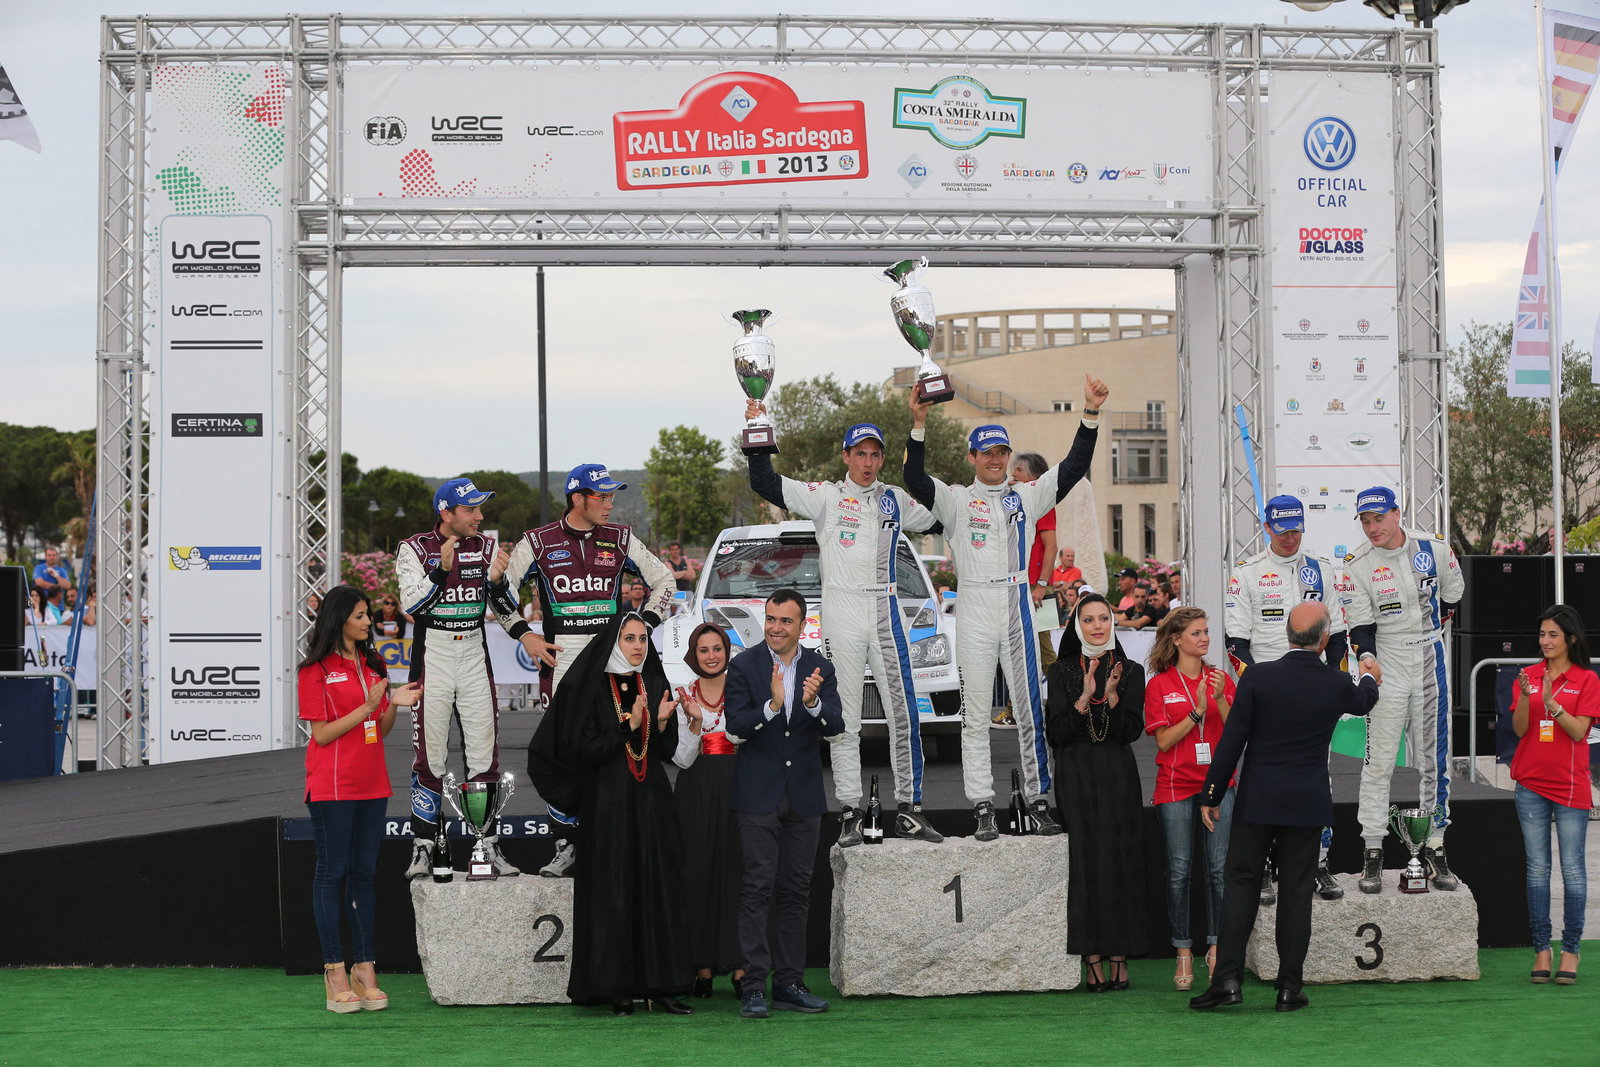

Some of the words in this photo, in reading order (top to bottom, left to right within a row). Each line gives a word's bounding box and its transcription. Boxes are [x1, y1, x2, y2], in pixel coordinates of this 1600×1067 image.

[902, 103, 943, 117] COSTA
[945, 107, 1016, 123] SMERALDA
[431, 116, 503, 131] WRC
[938, 118, 980, 127] SARDEGNA
[627, 129, 701, 156] RALLY
[706, 130, 757, 152] Italia
[762, 126, 854, 151] Sardegna
[632, 164, 712, 179] SARDEGNA
[777, 154, 829, 175] 2013
[1003, 169, 1056, 178] SARDEGNA
[1169, 166, 1191, 175] Coni
[1297, 177, 1367, 191] OFFICIAL
[1317, 194, 1347, 208] CAR
[1299, 227, 1364, 241] DOCTOR
[171, 240, 260, 259] WRC
[1312, 241, 1364, 254] GLASS
[176, 418, 243, 427] CERTINA
[553, 573, 612, 594] Qatar
[441, 584, 483, 603] atar
[457, 606, 481, 615] EDGE
[589, 604, 611, 613] EDGE
[799, 628, 821, 640] ed
[171, 666, 260, 685] WRC
[930, 669, 949, 679] EDGE
[942, 874, 964, 924] 1
[532, 914, 566, 963] 2
[1354, 922, 1384, 971] 3
